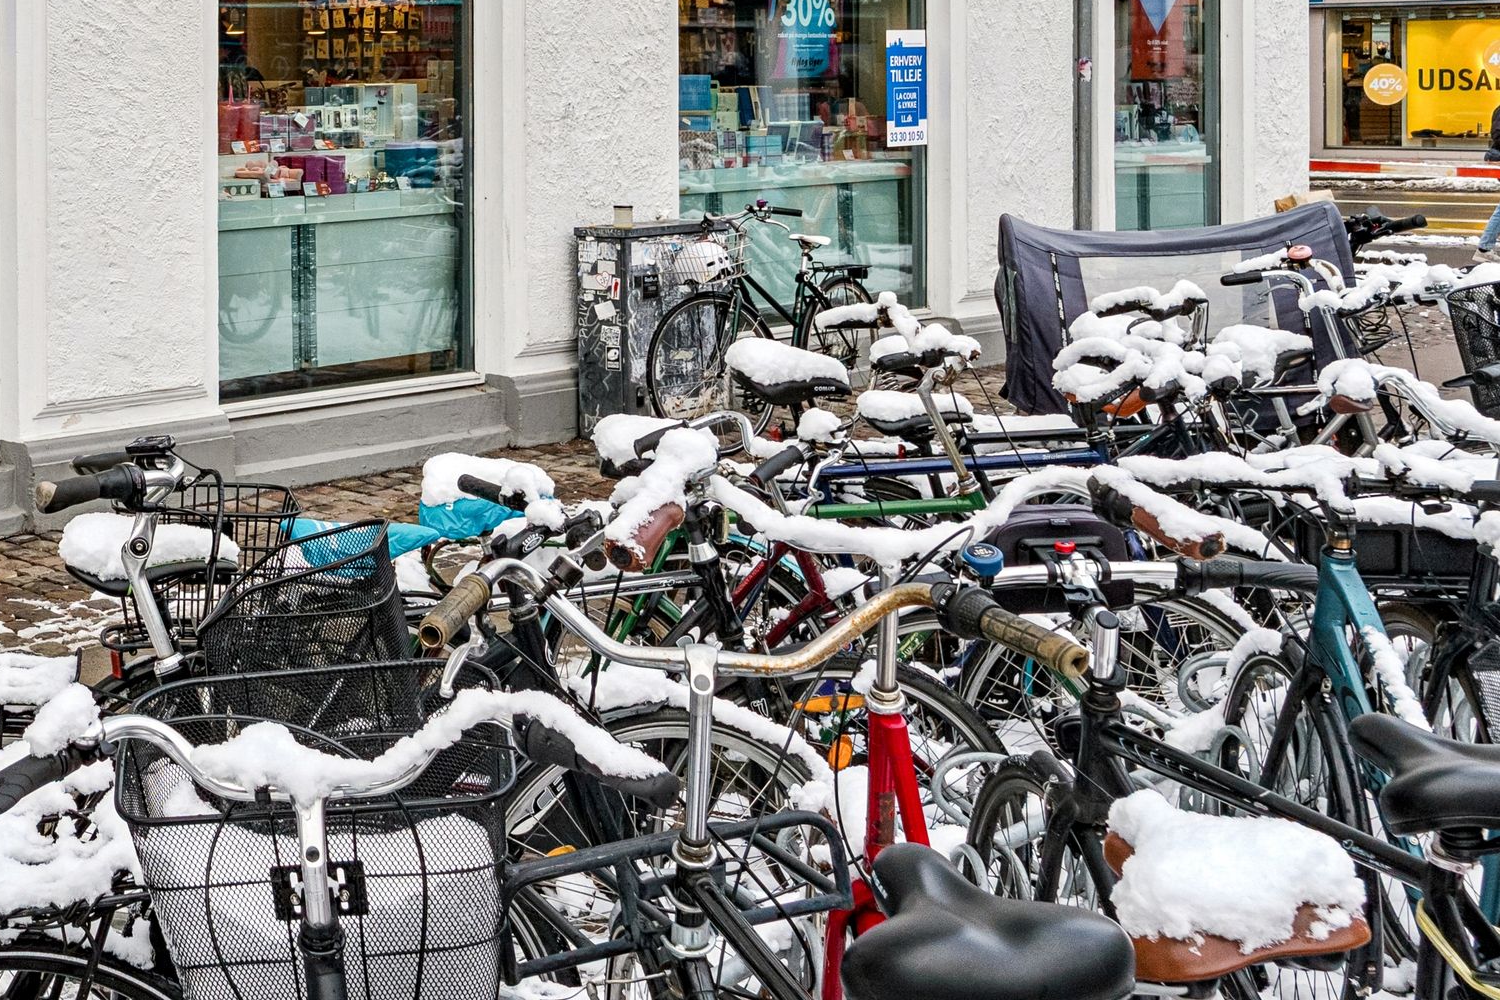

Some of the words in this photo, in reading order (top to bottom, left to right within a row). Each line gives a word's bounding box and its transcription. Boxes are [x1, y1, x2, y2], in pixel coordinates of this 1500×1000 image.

[890, 55, 922, 66] ERHVERV
[890, 69, 903, 82] TIL
[904, 69, 922, 82] LEJE
[1369, 78, 1402, 91] 40%
